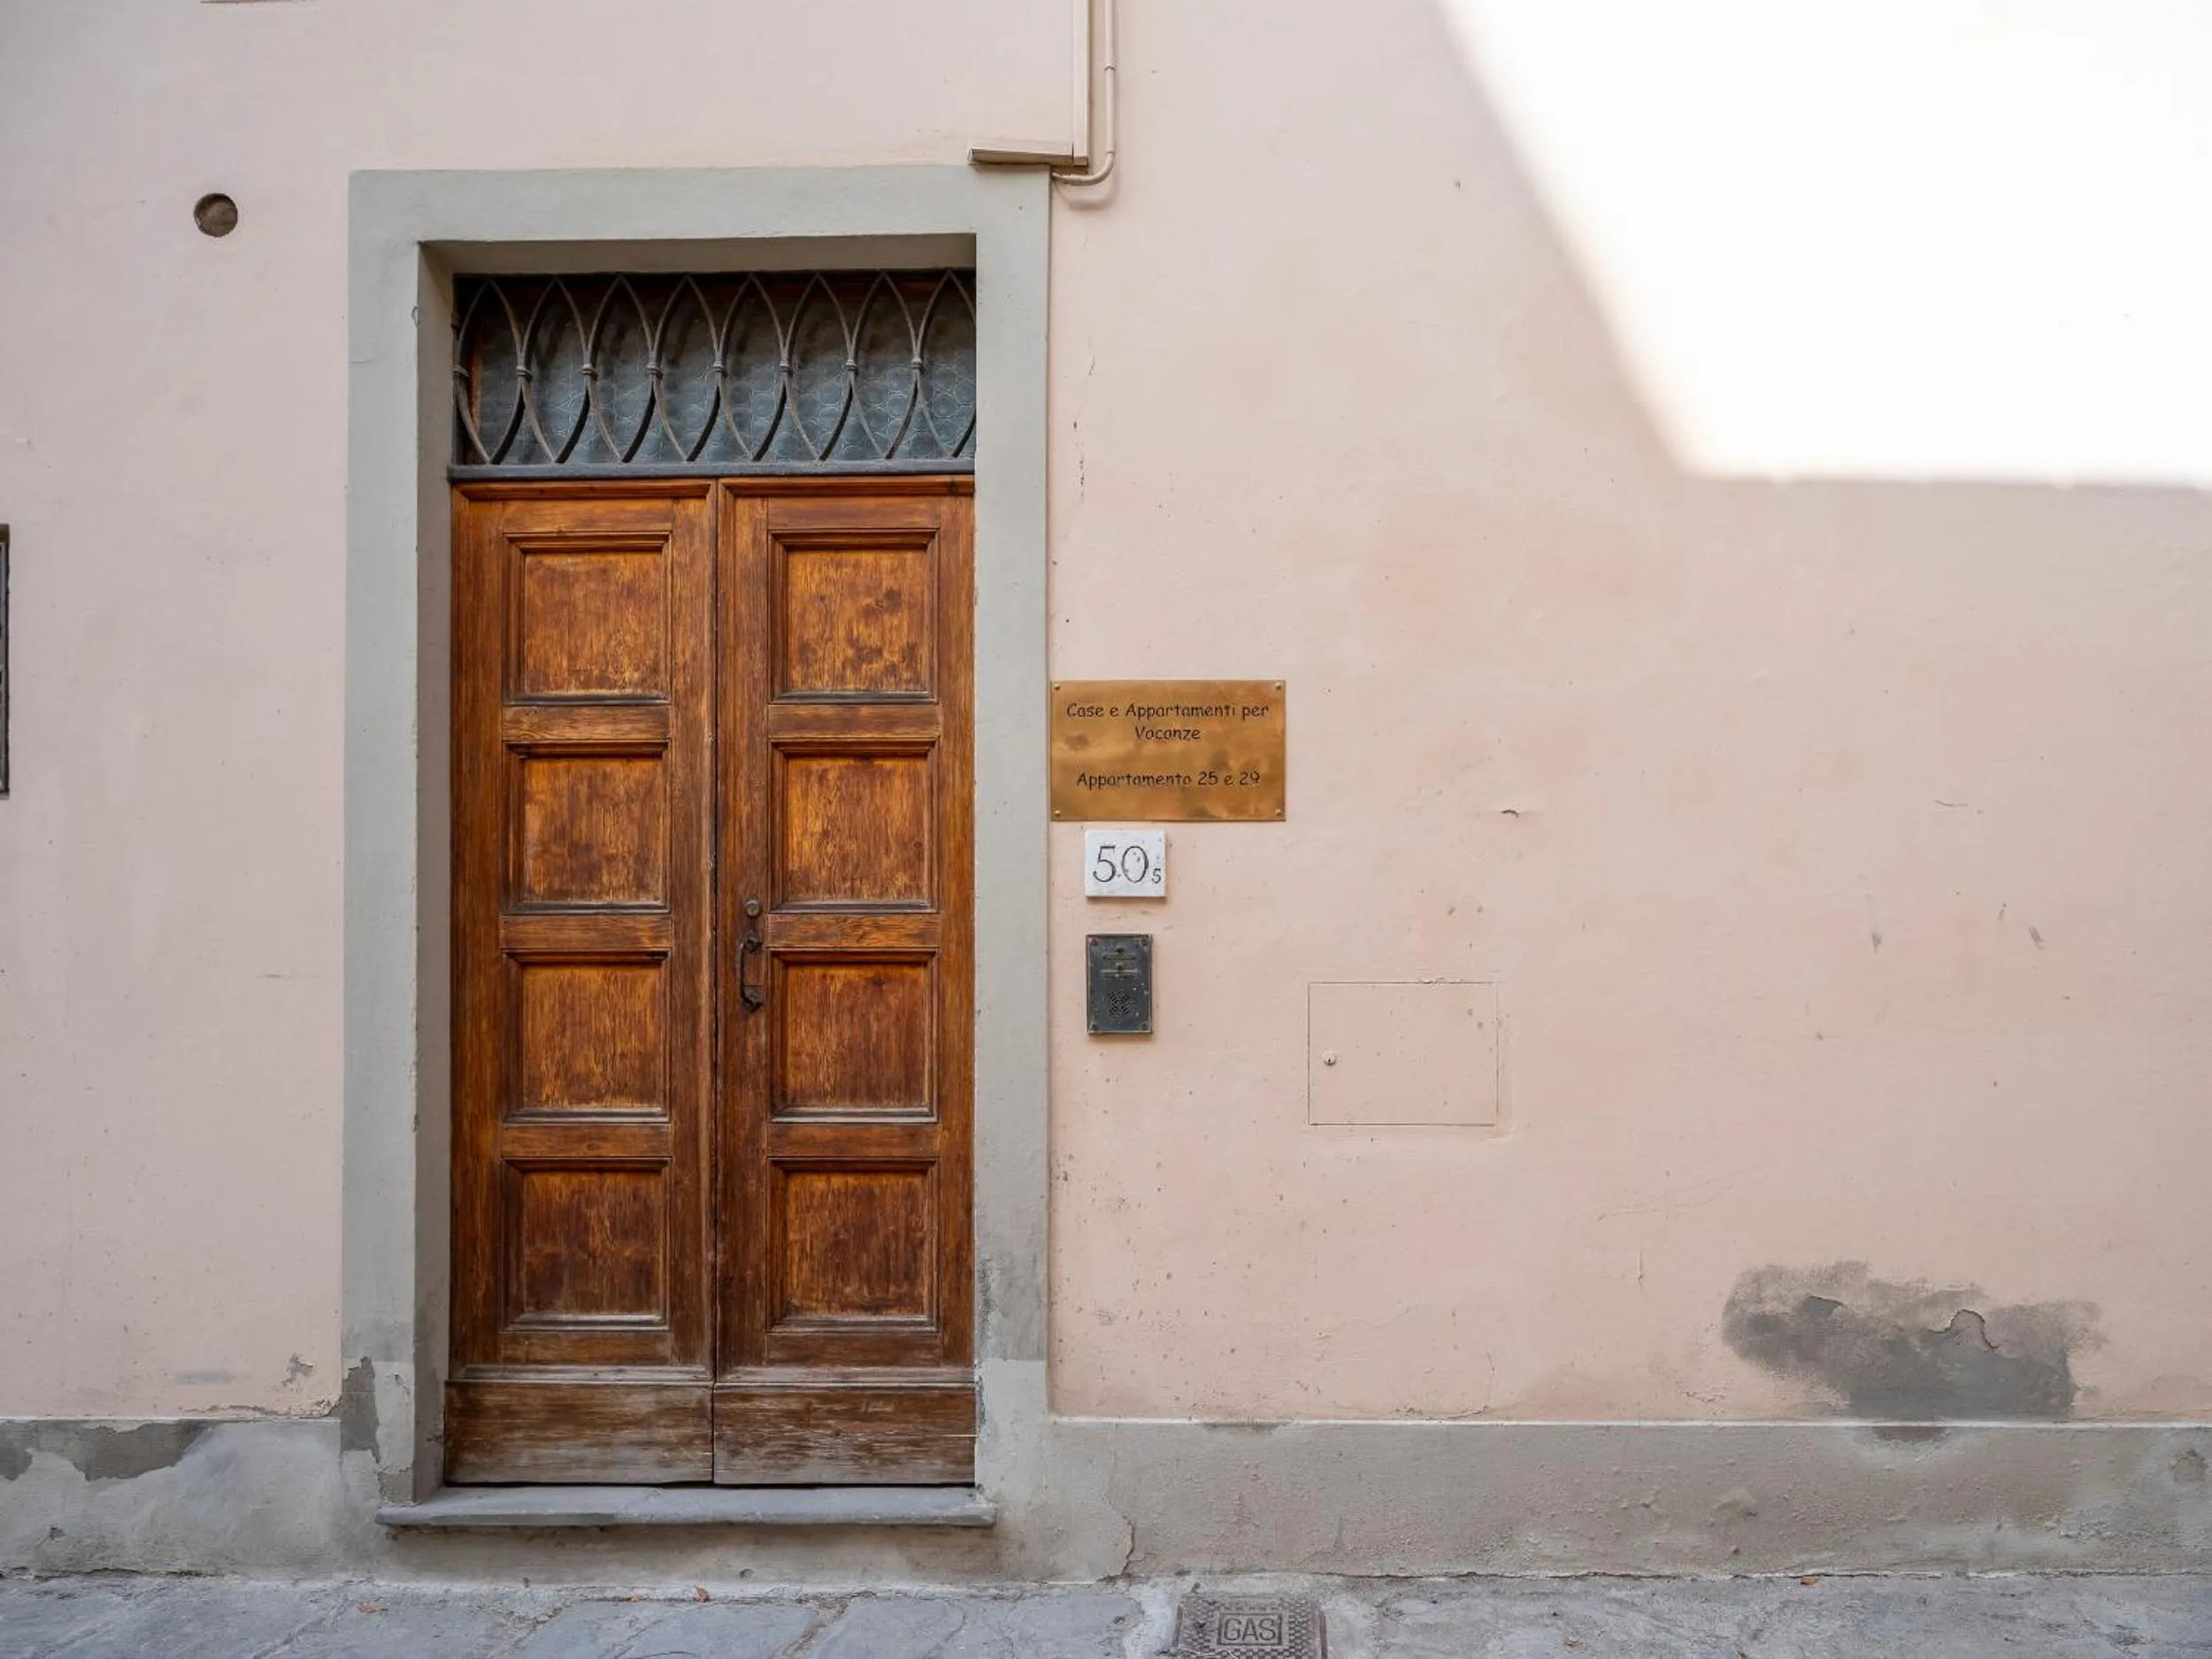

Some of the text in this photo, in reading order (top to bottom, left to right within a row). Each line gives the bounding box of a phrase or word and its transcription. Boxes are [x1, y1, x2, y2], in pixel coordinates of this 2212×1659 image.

[1066, 703, 1269, 722] Case e Appartamenti per
[1134, 726, 1201, 741] Vacanze
[1076, 772, 1260, 790] Appartamento 25 e 29
[1223, 1618, 1277, 1641] GAS
